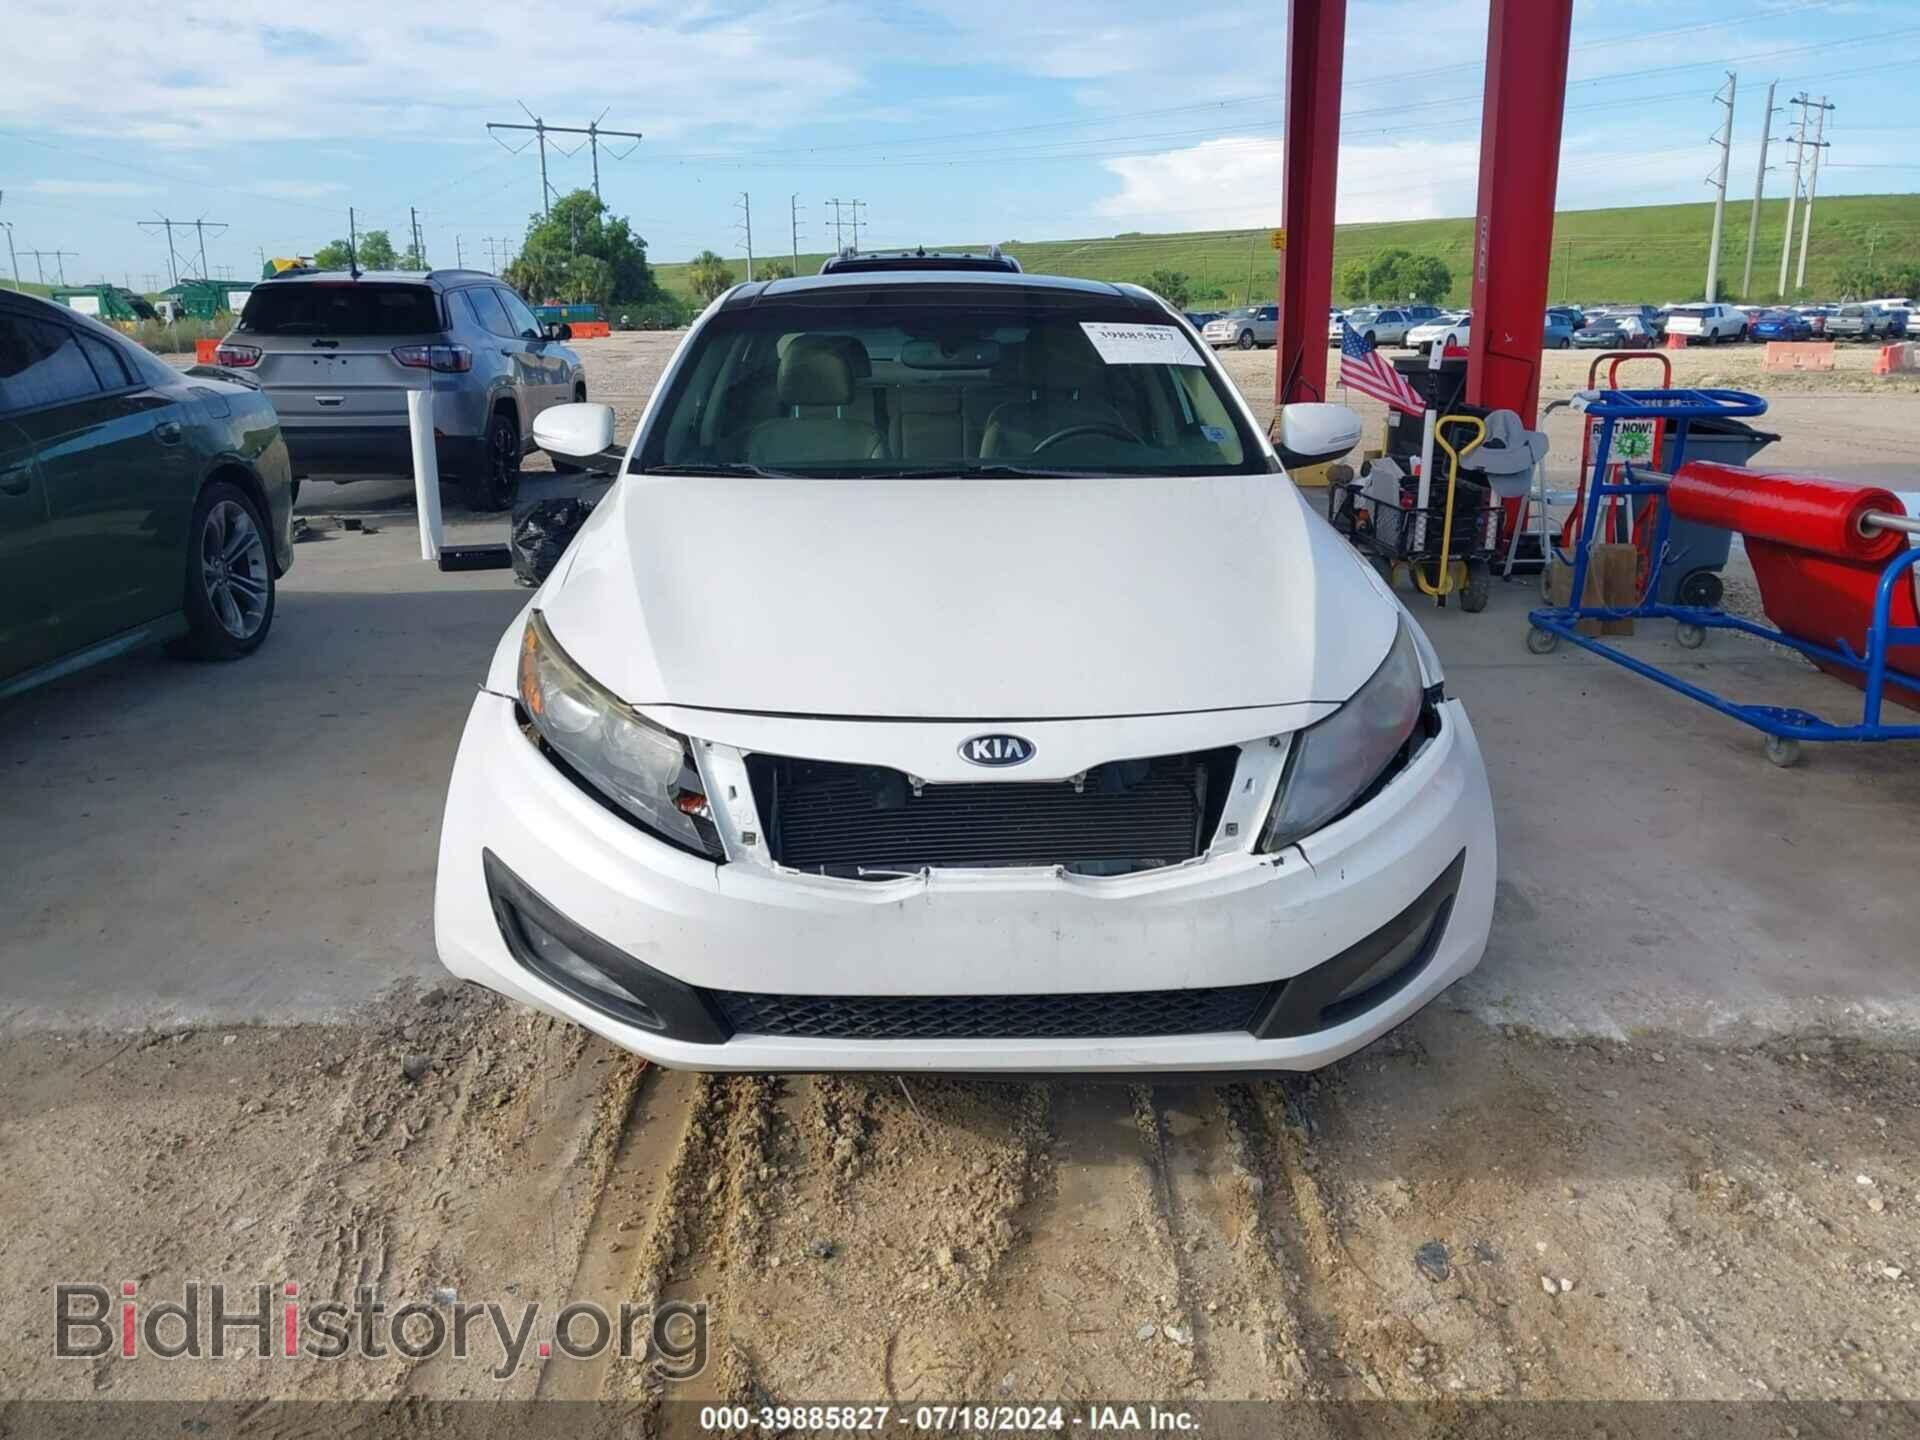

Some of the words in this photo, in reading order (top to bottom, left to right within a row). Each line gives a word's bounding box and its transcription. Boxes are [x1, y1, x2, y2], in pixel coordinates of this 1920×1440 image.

[1593, 423, 1621, 434] RET
[1623, 422, 1653, 434] NOW!
[972, 738, 1024, 760] KIA
